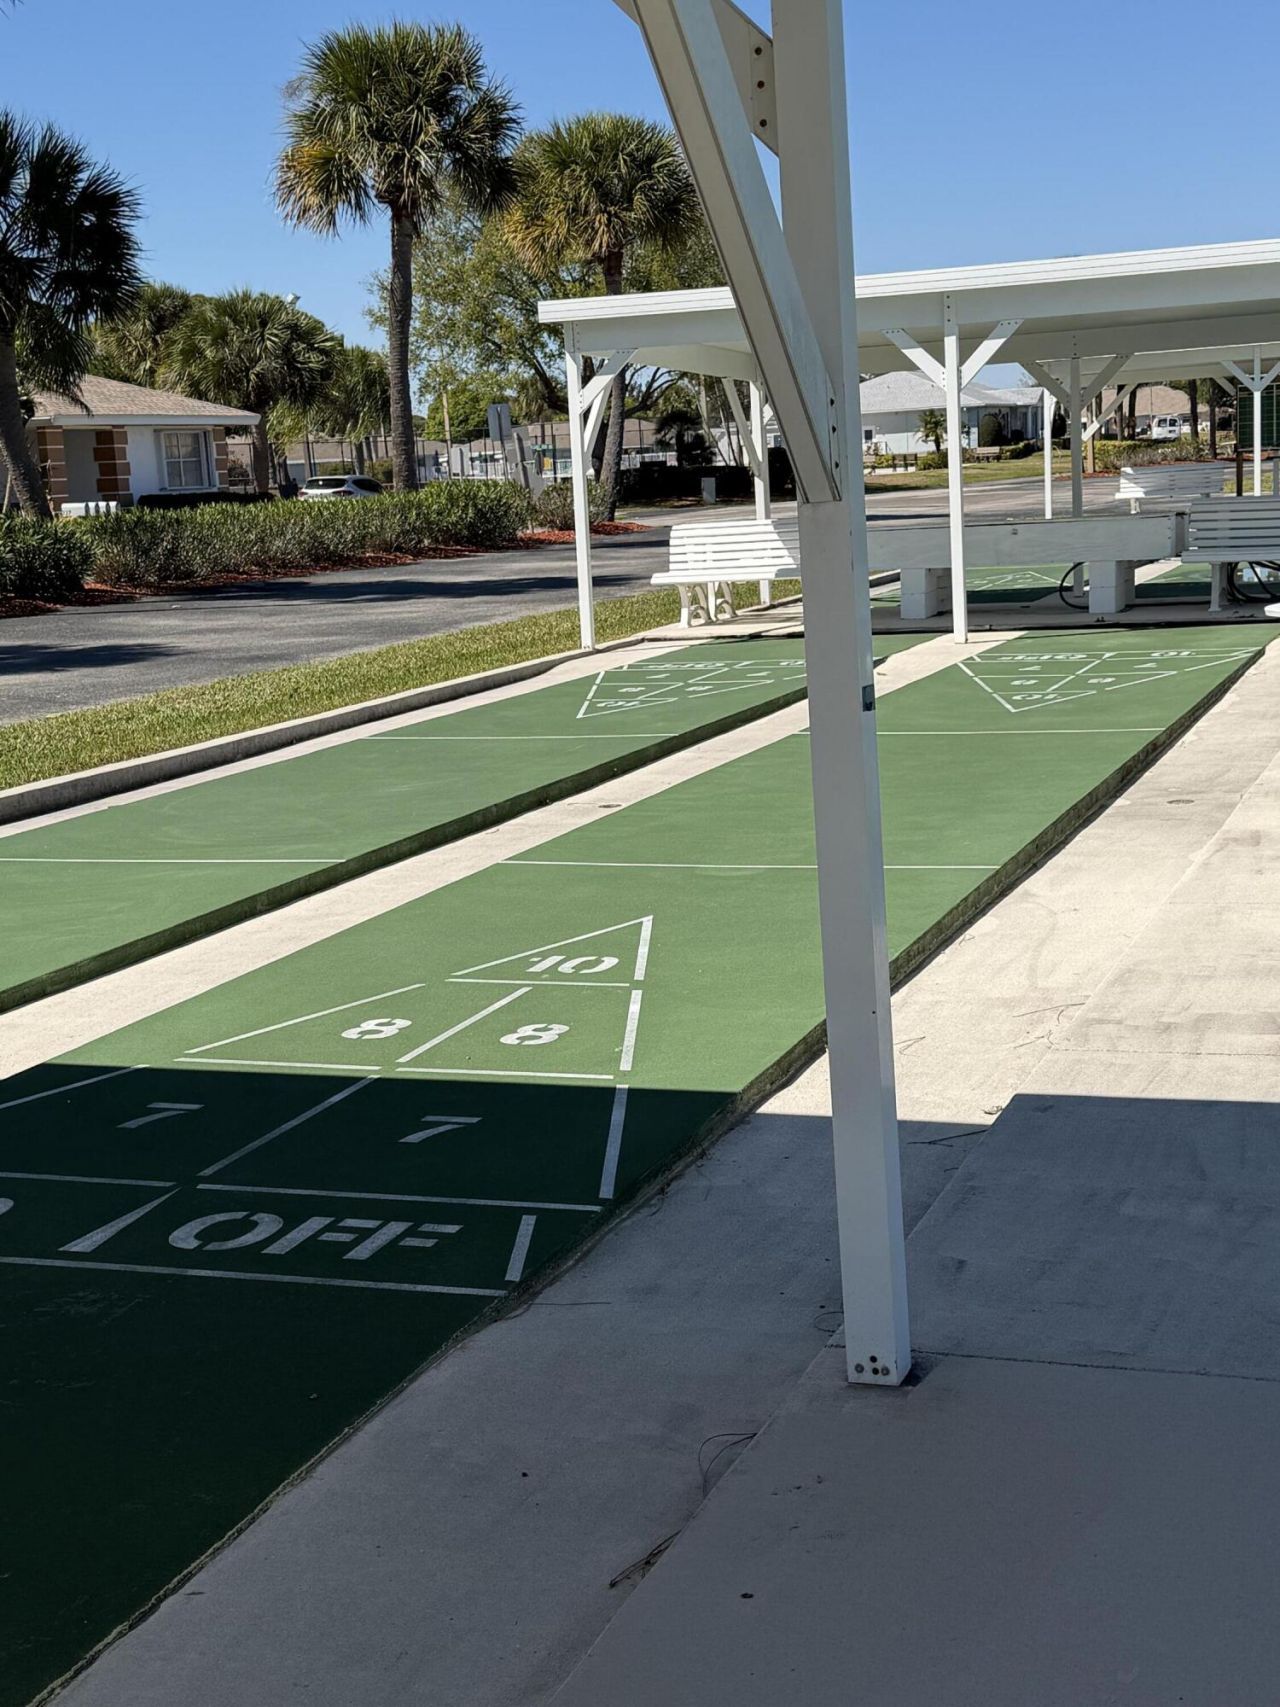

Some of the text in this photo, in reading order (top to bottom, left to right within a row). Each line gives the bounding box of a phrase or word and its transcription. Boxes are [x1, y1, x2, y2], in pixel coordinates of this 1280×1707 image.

[525, 955, 619, 976] 10
[340, 1017, 413, 1041] 8
[499, 1023, 570, 1046] 8
[116, 1102, 205, 1129] 7
[398, 1115, 483, 1143] 7
[168, 1211, 464, 1260] OFF
